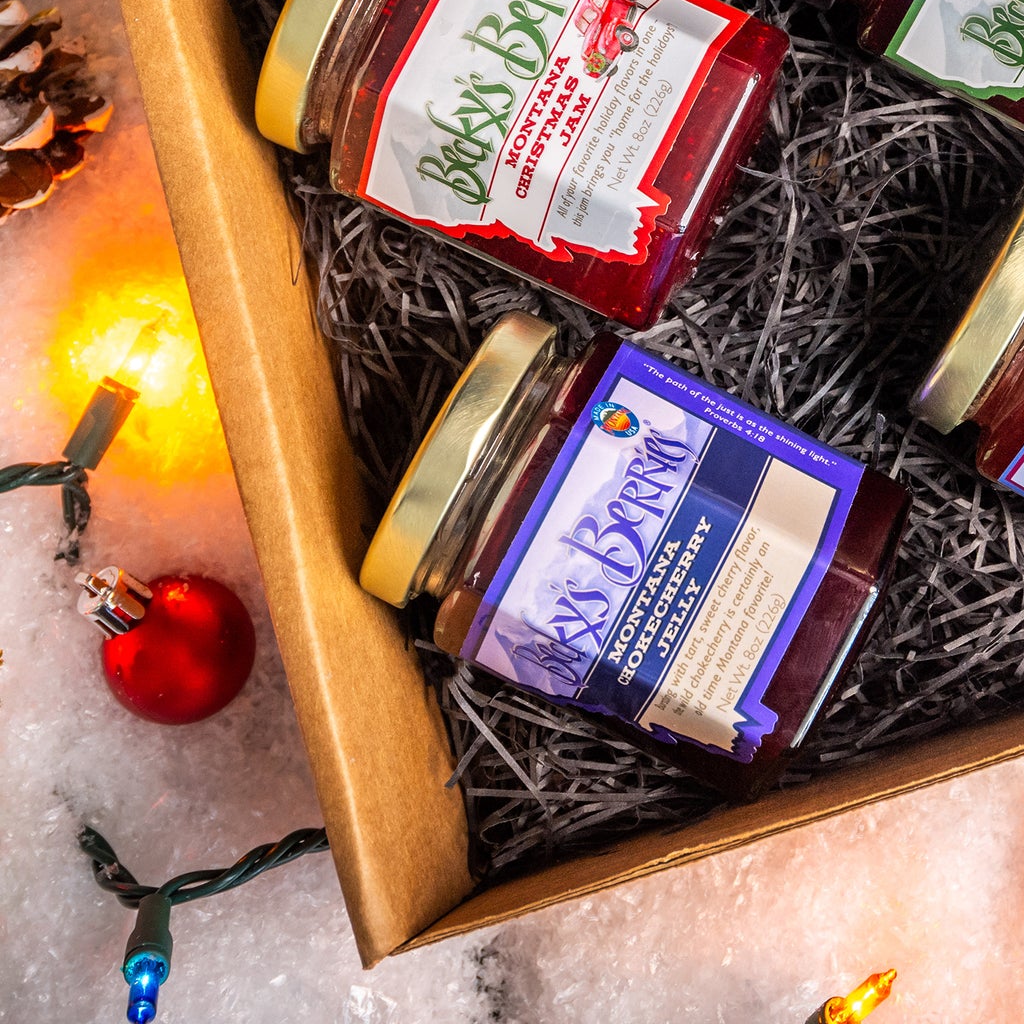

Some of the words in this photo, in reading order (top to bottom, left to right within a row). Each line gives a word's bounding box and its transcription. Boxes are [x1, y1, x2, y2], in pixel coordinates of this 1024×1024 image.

[633, 44, 645, 57] in
[640, 23, 656, 45] one
[613, 56, 639, 95] flavors
[628, 85, 642, 104] for
[637, 65, 653, 87] the
[503, 54, 570, 169] MONTANA
[556, 92, 592, 147] JAM
[592, 93, 622, 134] holiday
[411, 70, 514, 204] Becky's
[513, 73, 580, 200] CHRISTMAS
[573, 133, 601, 178] favorite
[600, 141, 616, 164] you
[565, 178, 579, 203] your
[581, 161, 607, 197] brings
[555, 203, 568, 218] All
[561, 195, 571, 207] of
[570, 210, 585, 227] this
[577, 196, 590, 215] jam
[624, 425, 638, 436] USA
[664, 376, 688, 393] path
[688, 388, 702, 399] of
[700, 394, 716, 407] the
[715, 402, 735, 417] just
[735, 412, 745, 422] is
[745, 419, 757, 428] as
[757, 424, 775, 437] the
[774, 432, 808, 456] shining
[703, 407, 744, 432] Proverbs
[743, 427, 766, 444] 4:18
[558, 428, 698, 587] Berries
[607, 540, 682, 664] MONTANA
[616, 515, 712, 686] CHOKECHERRY
[654, 577, 703, 658] JELLY
[668, 660, 689, 687] with
[682, 633, 705, 660] tart,
[698, 598, 722, 633] sweet
[715, 561, 743, 598] cherry
[734, 524, 761, 561] flavor,
[511, 577, 611, 686] Becky's
[677, 687, 694, 708] wild
[686, 618, 731, 688] chokecherry
[723, 606, 735, 619] is
[730, 556, 764, 607] certainly
[757, 540, 771, 558] an
[693, 700, 707, 716] old
[700, 672, 722, 701] time
[715, 618, 751, 673] Montana
[743, 570, 774, 620] favorite!
[715, 684, 738, 713] Net
[728, 659, 750, 687] Wt.
[741, 634, 763, 661] 8oz
[755, 592, 786, 635] (226g)
